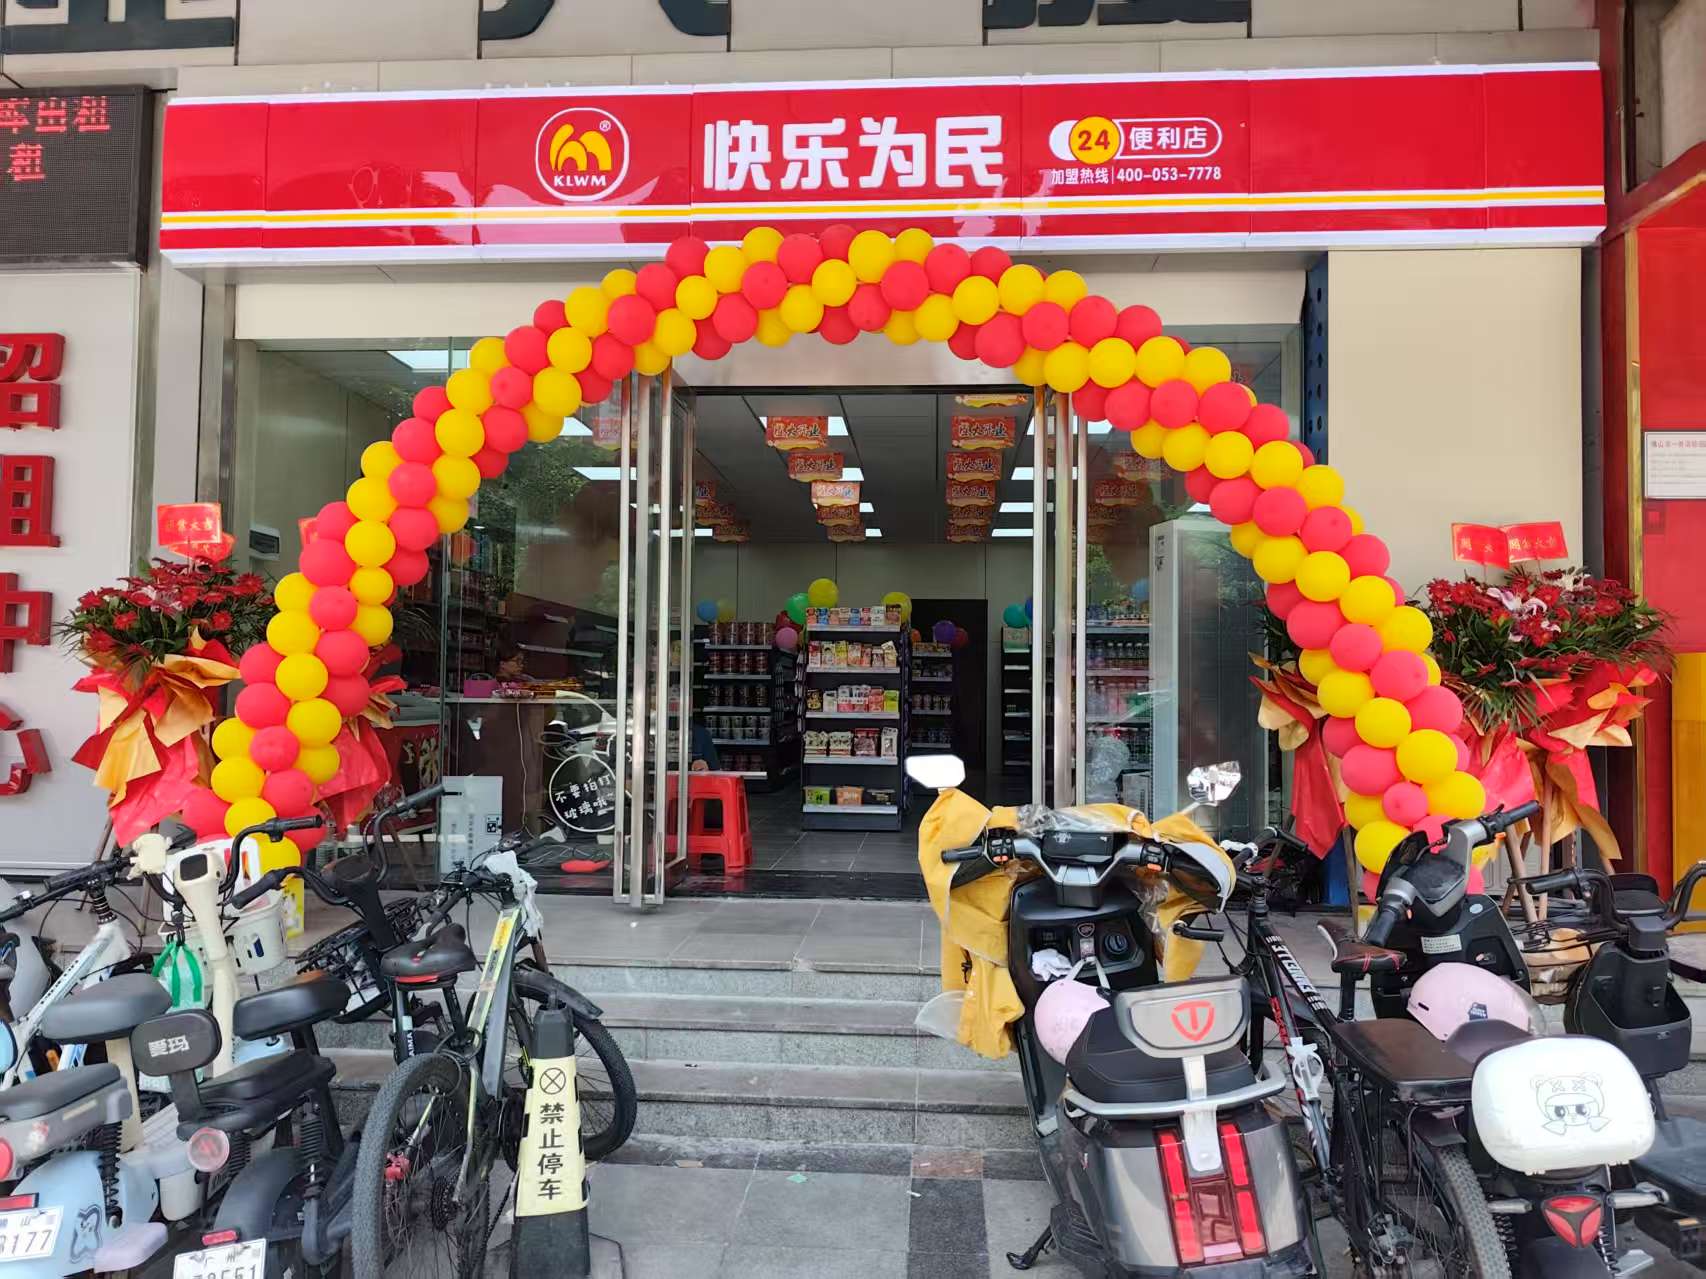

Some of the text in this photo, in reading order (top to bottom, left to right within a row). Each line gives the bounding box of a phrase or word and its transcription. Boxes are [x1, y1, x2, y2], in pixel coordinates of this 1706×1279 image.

[1077, 126, 1209, 151] 24 便利店
[703, 115, 1003, 191] 快乐为民
[553, 174, 607, 188] KLWM
[1050, 166, 1222, 185] 加盟热线 400-053-7778
[555, 774, 611, 803] 不要拍打
[537, 1102, 565, 1200] 禁止停车
